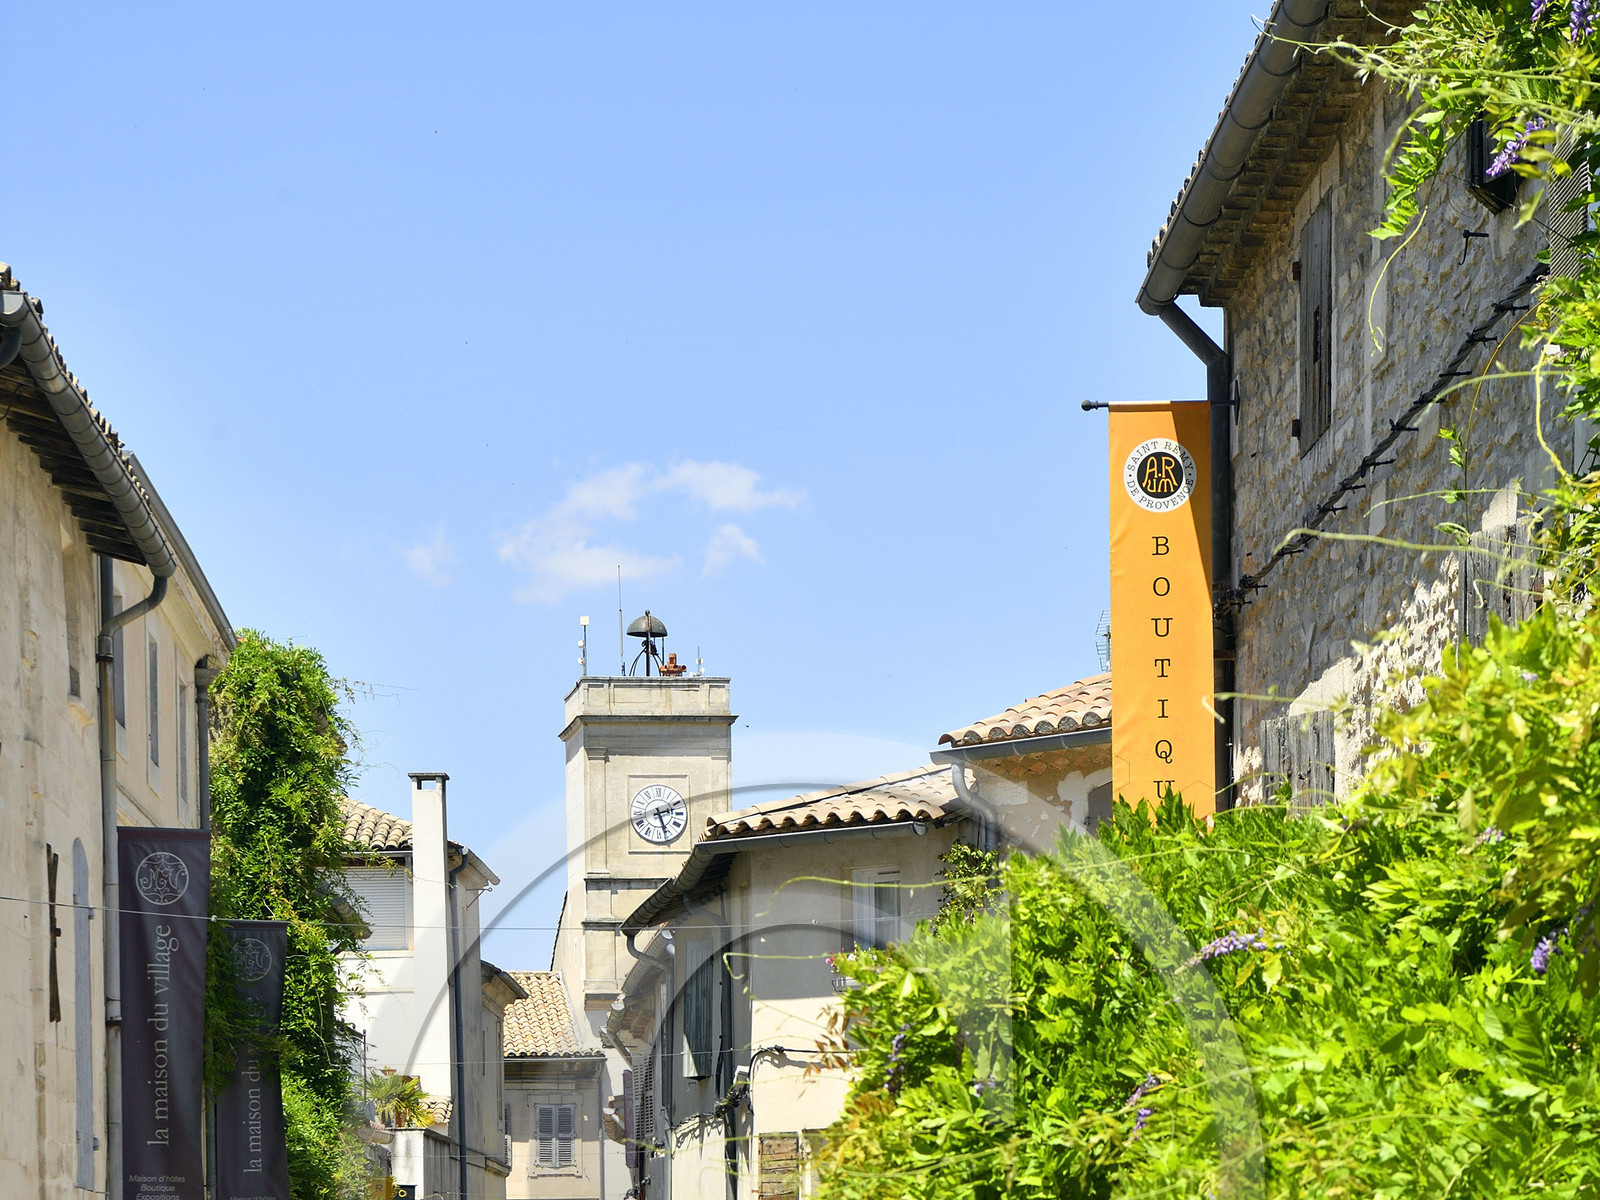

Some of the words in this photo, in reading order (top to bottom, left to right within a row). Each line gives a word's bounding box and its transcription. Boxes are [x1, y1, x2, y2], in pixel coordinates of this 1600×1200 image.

[1126, 440, 1158, 472] SAINT
[1164, 440, 1194, 470] REMY
[1126, 480, 1140, 497] DE
[1138, 478, 1194, 510] PROVENCE
[147, 925, 180, 996] village
[147, 1003, 169, 1031] du
[147, 1038, 169, 1121] maison
[241, 1060, 261, 1082] du
[242, 1087, 261, 1153] maison
[147, 1127, 169, 1146] la
[129, 1175, 156, 1183] Maison
[243, 1158, 262, 1173] la
[140, 1183, 176, 1193] Boutique
